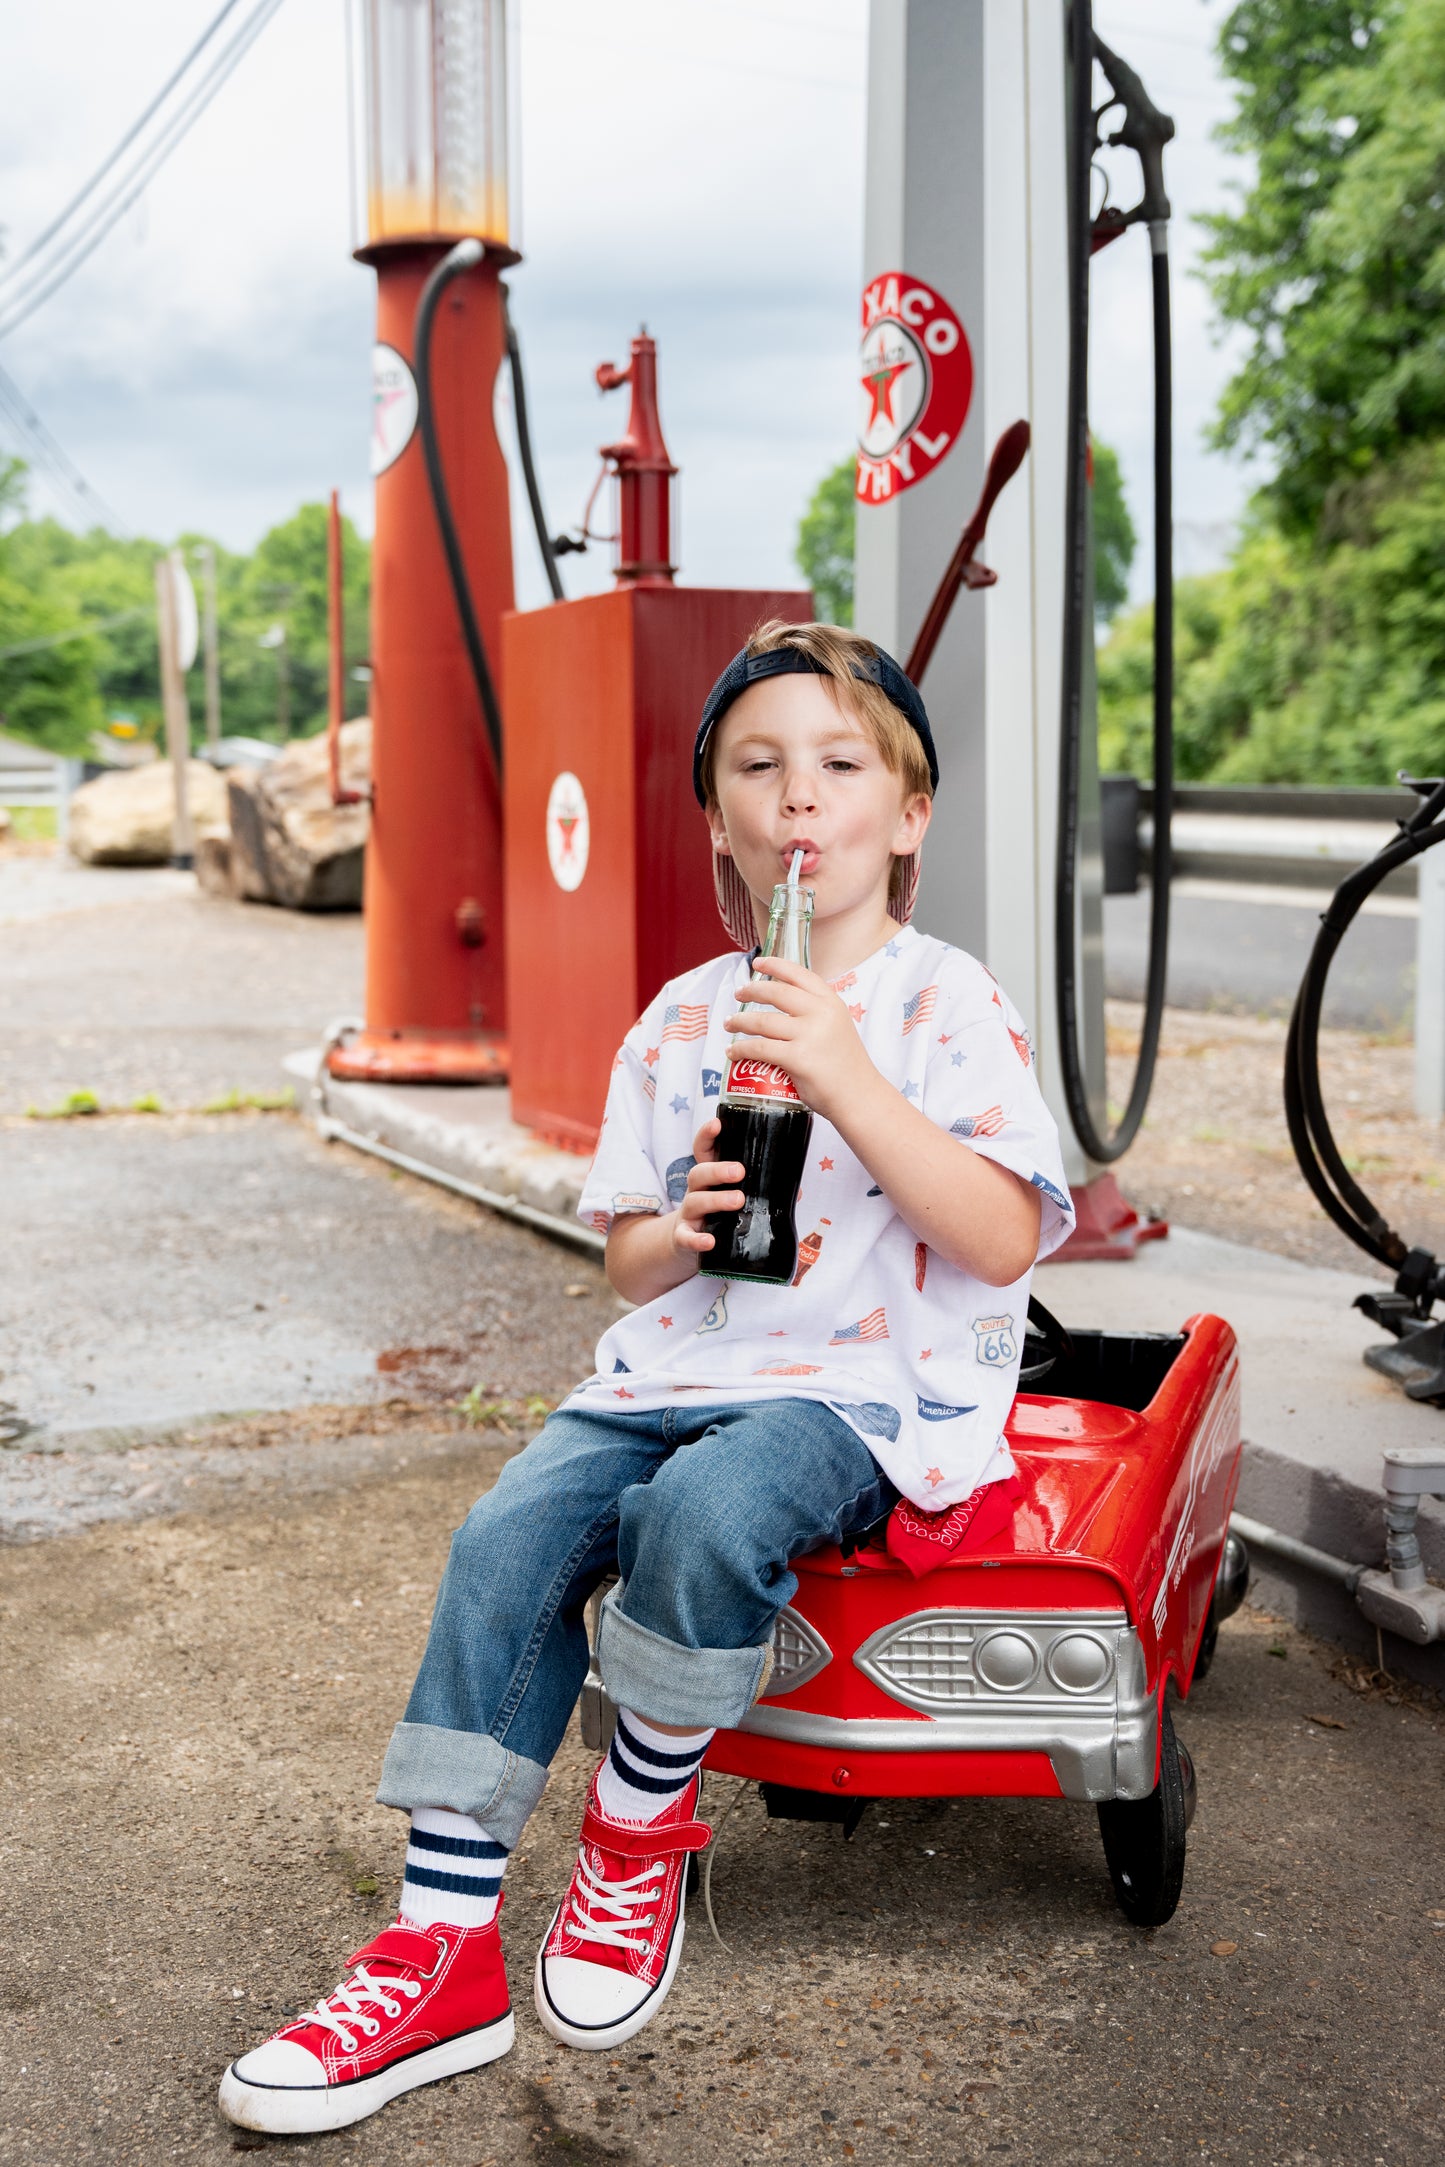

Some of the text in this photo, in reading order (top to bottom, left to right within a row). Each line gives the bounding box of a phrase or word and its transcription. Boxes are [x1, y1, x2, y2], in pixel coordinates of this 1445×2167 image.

[730, 1085, 756, 1094] REFRESCO
[621, 1196, 654, 1207] ROUTE
[980, 1318, 1006, 1331] ROUTE
[984, 1332, 1012, 1362] 66
[918, 1400, 959, 1416] America
